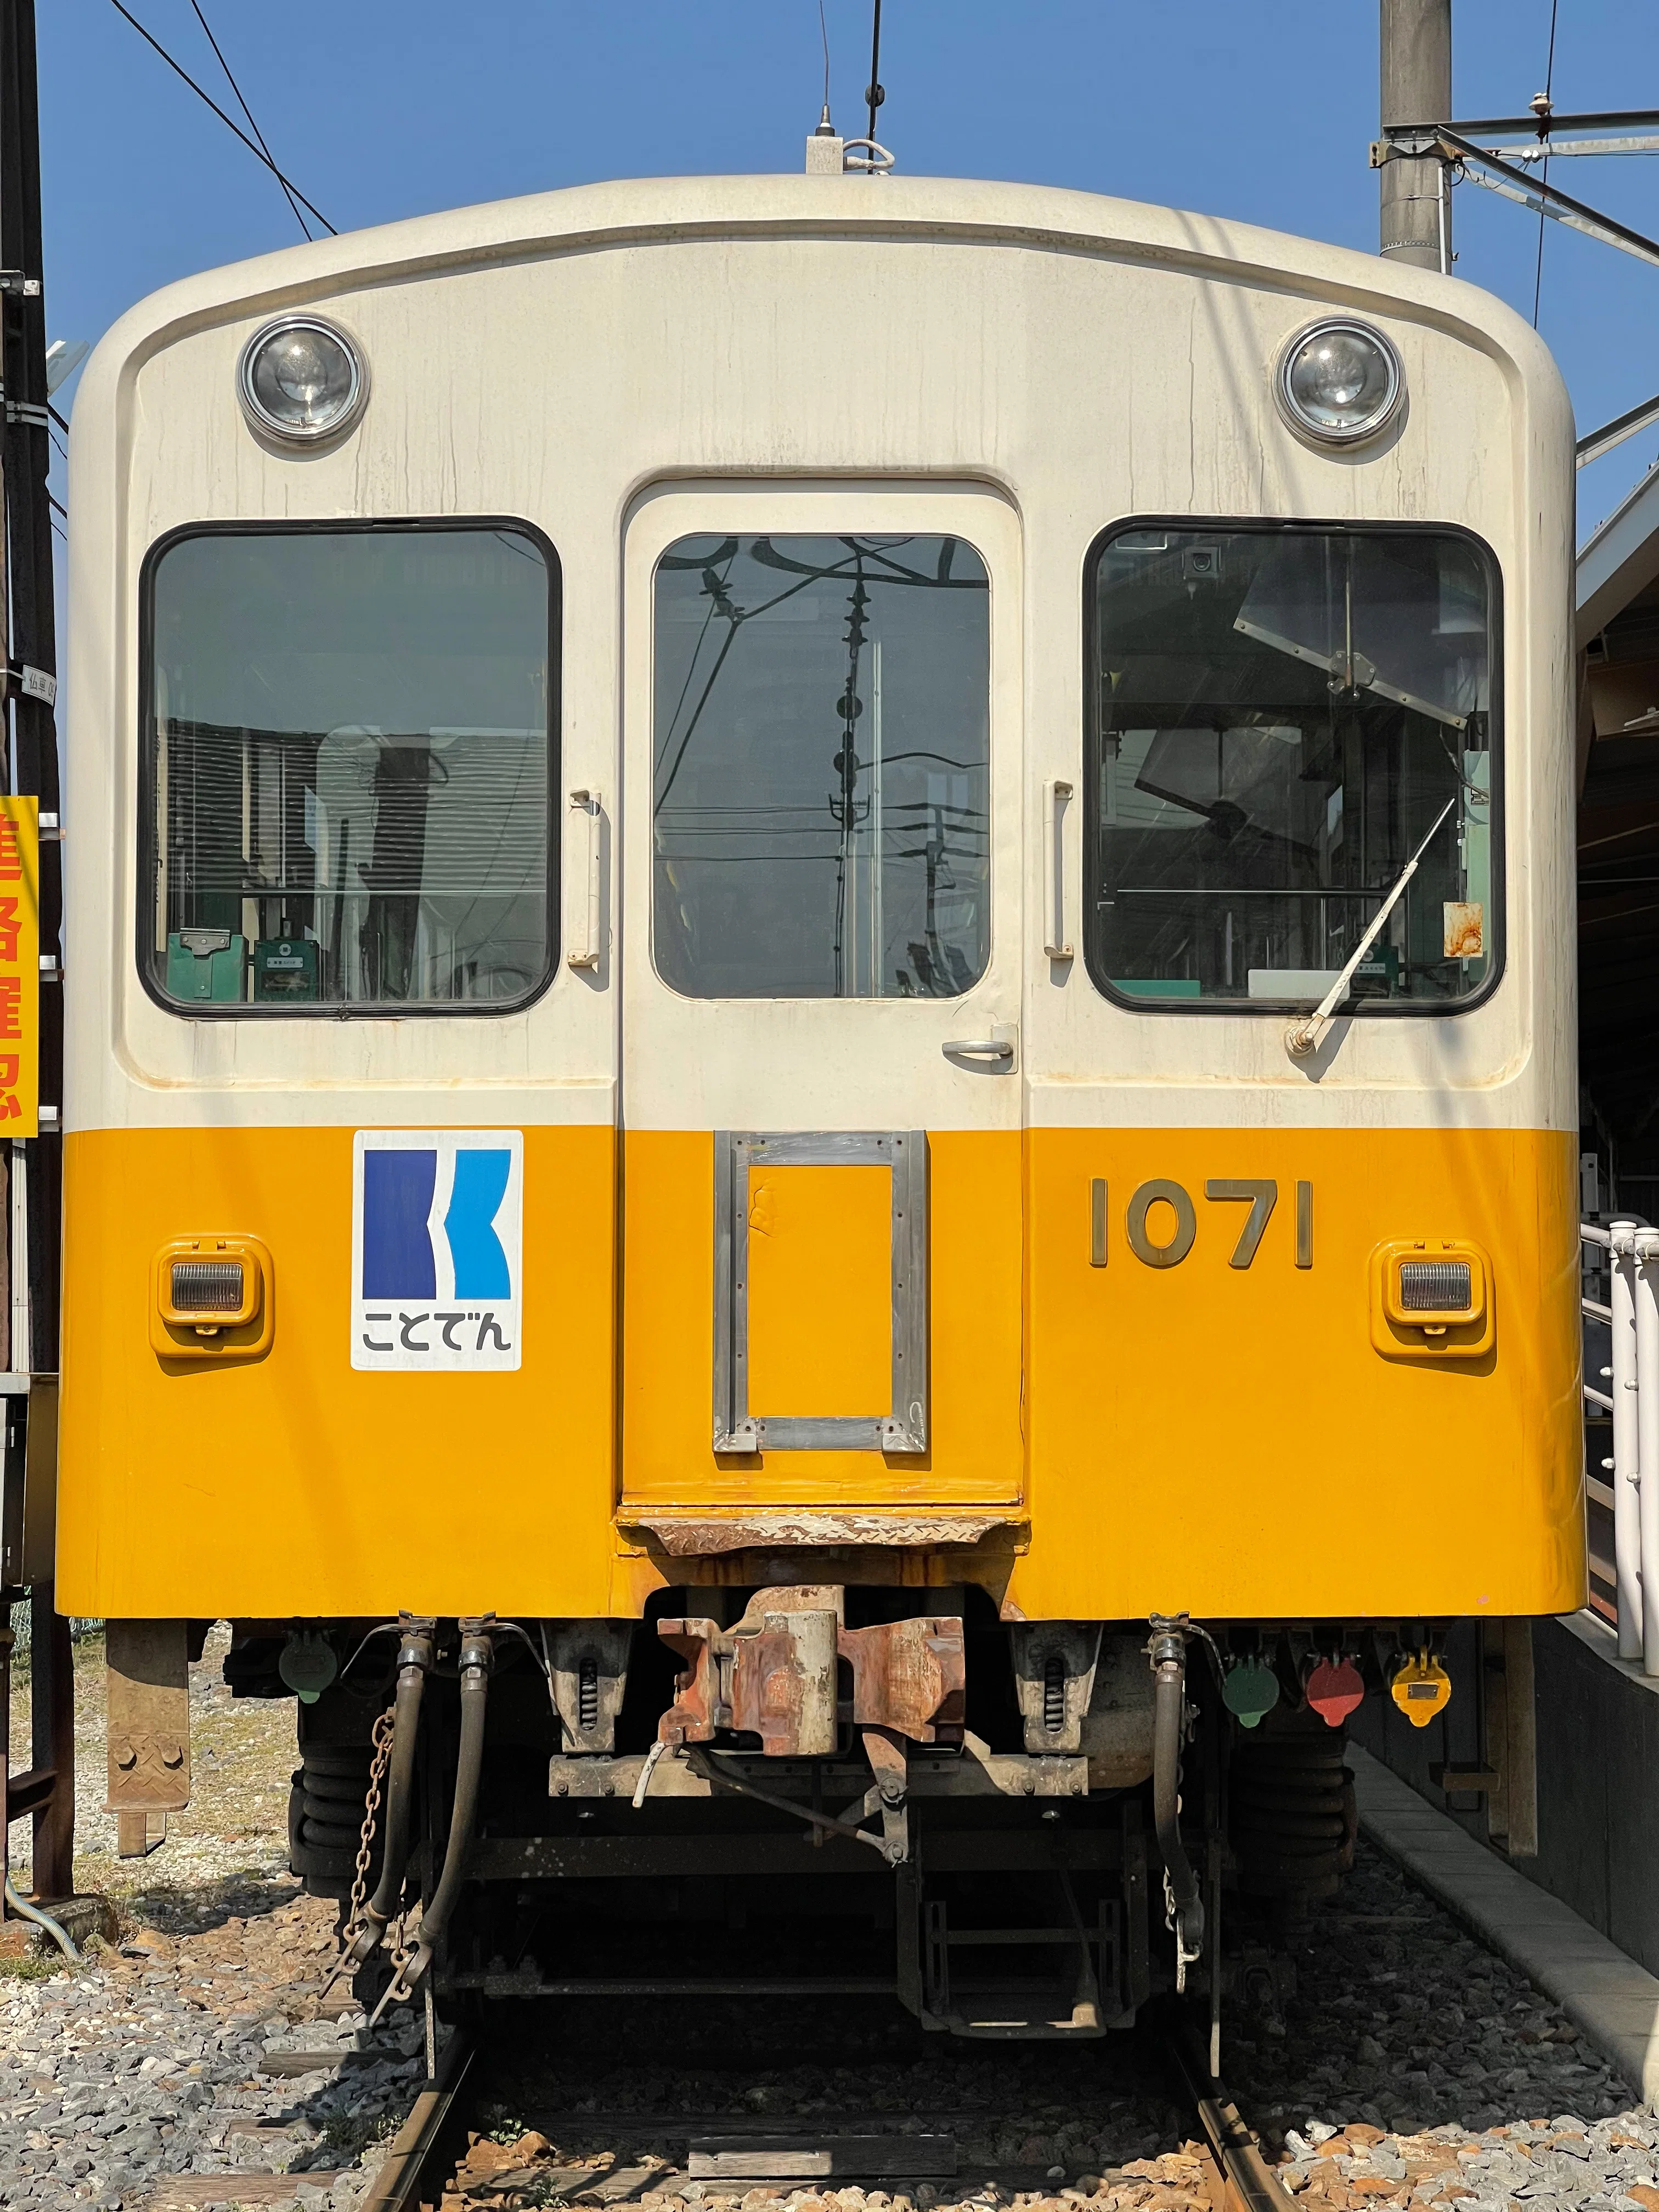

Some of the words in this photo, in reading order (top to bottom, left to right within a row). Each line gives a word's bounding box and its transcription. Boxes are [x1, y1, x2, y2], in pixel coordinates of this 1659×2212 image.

[1089, 1178, 1313, 1269] 1071
[363, 1312, 511, 1351] ことでん
